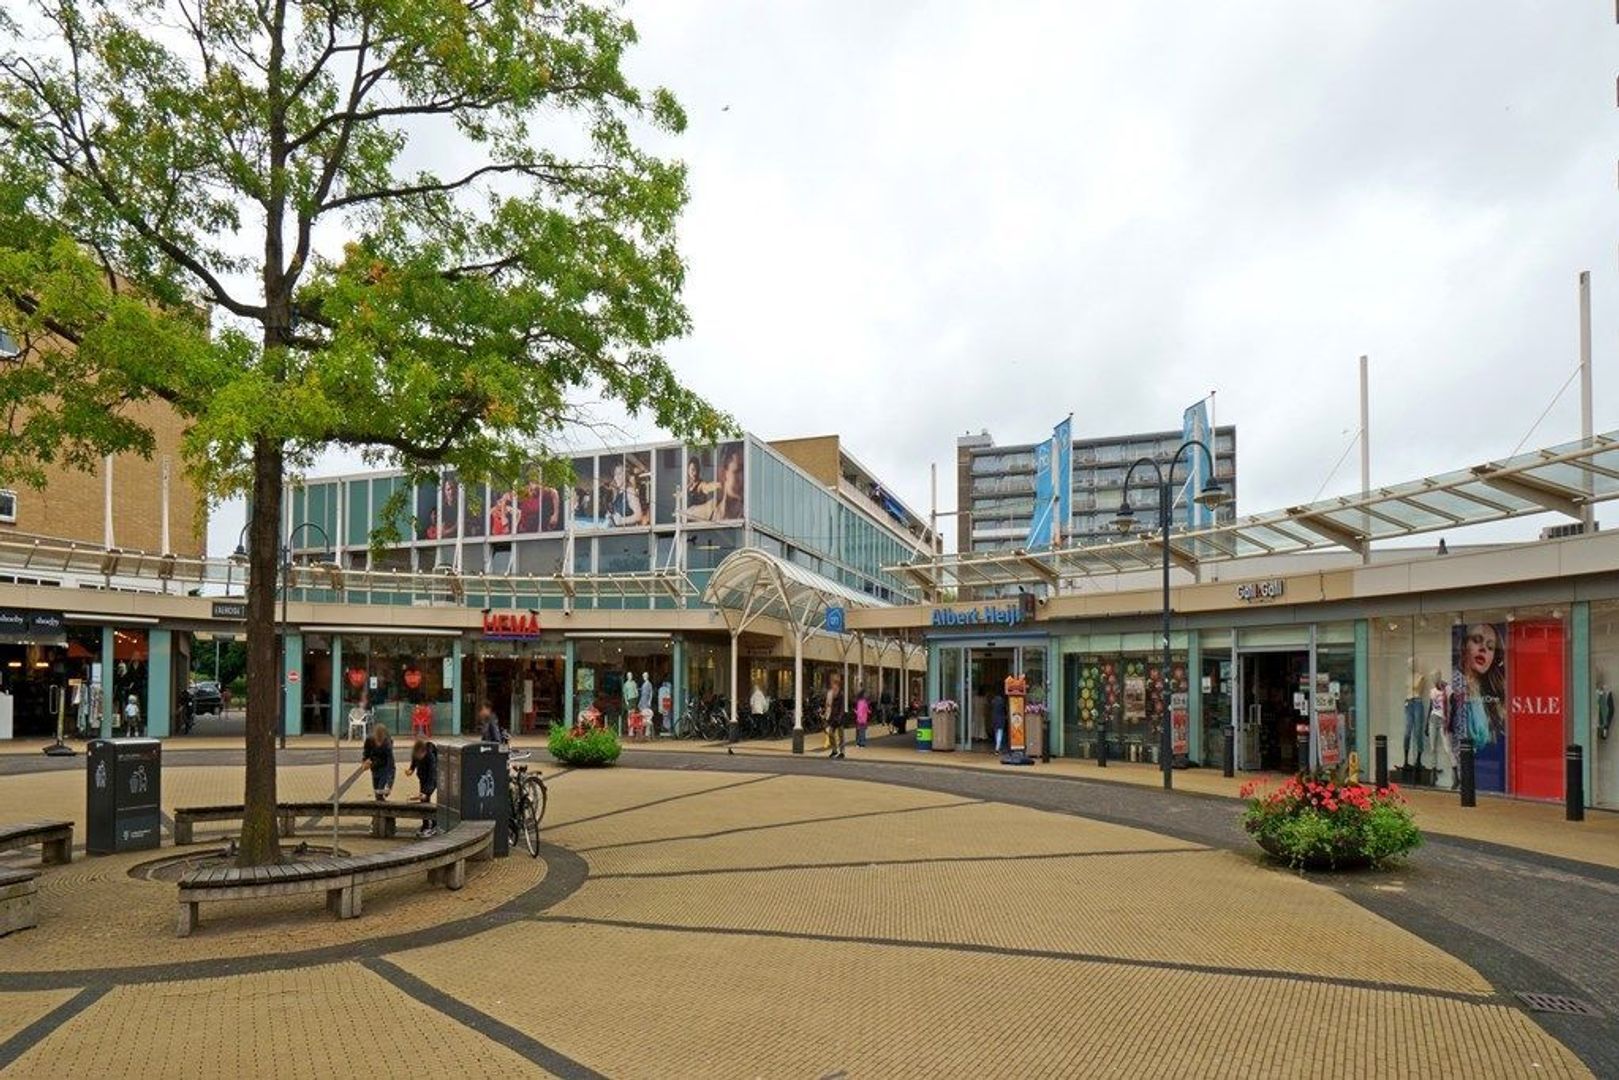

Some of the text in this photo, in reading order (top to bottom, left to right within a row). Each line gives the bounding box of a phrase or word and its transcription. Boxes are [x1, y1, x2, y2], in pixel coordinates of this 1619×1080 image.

[1262, 579, 1284, 597] Gall
[483, 613, 540, 634] HEMA
[932, 608, 977, 625] Albert
[1511, 697, 1560, 714] SALE
